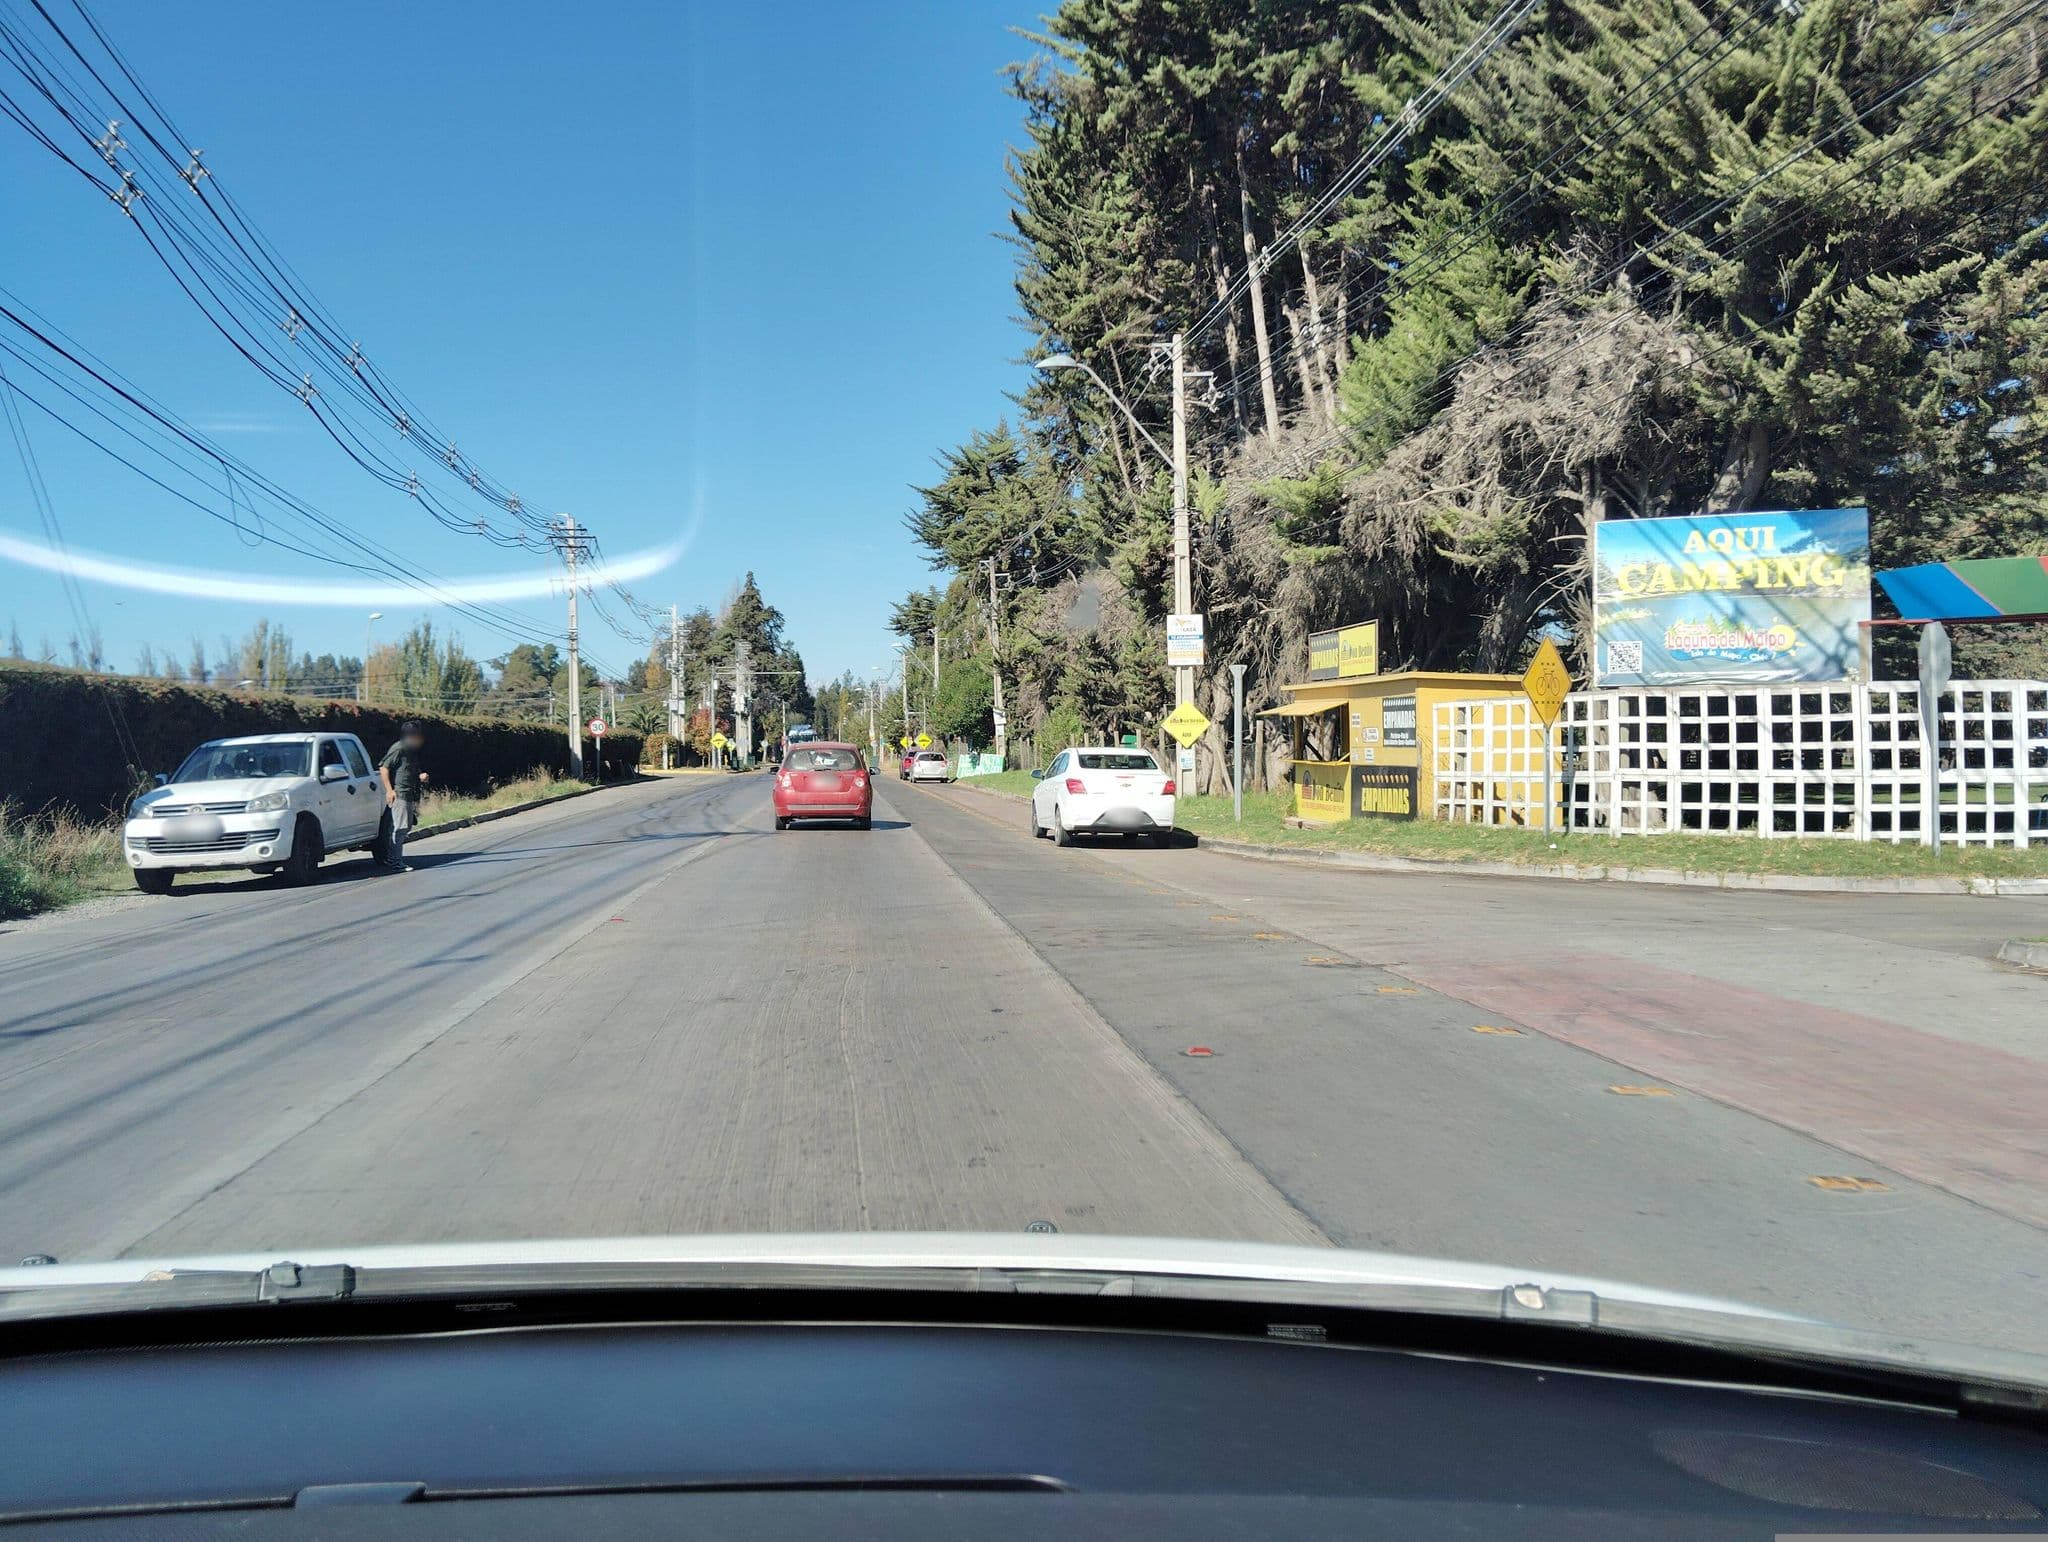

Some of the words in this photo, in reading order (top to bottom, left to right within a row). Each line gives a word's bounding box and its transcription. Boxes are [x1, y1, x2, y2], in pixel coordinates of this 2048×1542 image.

[1683, 526, 1776, 554] AQUI
[1616, 554, 1848, 593] CAMPING
[1667, 632, 1718, 651] Laguna
[1720, 631, 1740, 647] del
[1744, 631, 1786, 649] Maipo
[592, 723, 604, 731] 30
[1383, 710, 1416, 729] EMPANADAS
[1361, 787, 1410, 815] EMPANADAS
